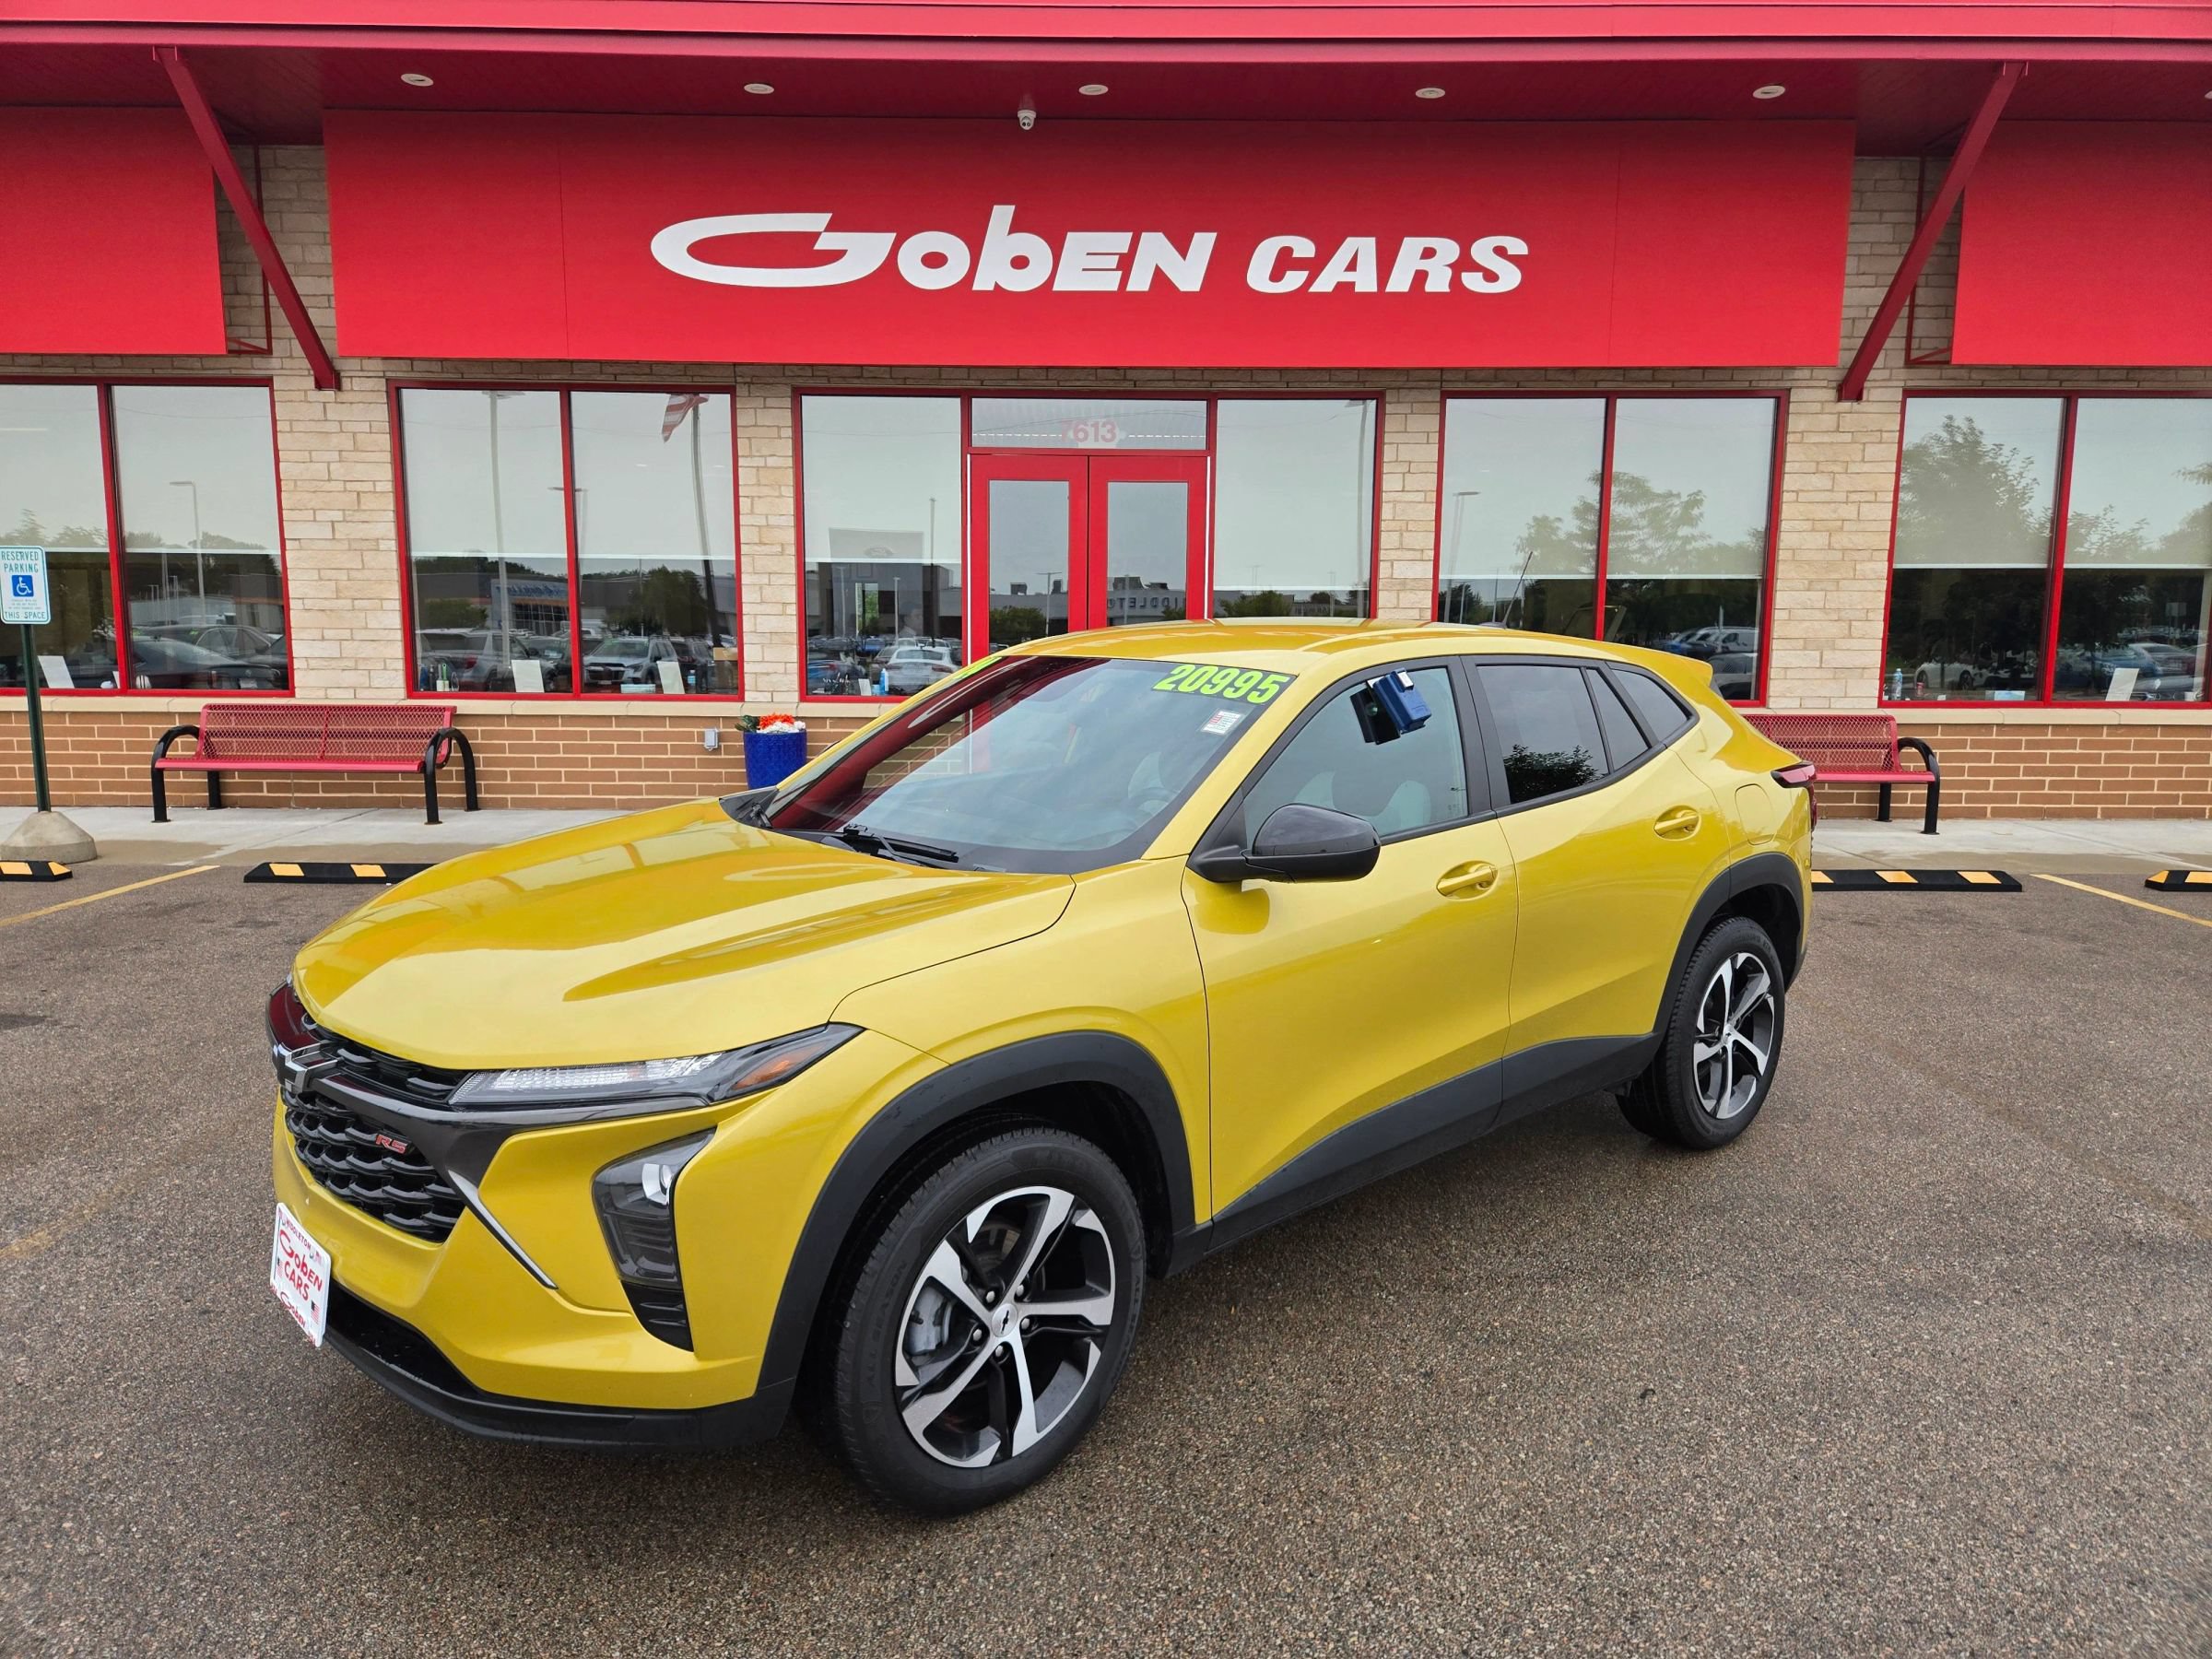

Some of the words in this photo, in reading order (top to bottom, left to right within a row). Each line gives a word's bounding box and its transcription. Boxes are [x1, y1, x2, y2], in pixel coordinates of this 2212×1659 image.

[1247, 234, 1529, 295] CARS
[1, 550, 40, 561] RESERVED
[4, 562, 40, 573] PARKING
[5, 611, 20, 619] THIS
[24, 611, 46, 619] SPACE
[1152, 664, 1291, 705] 20995
[375, 1134, 407, 1154] RS
[284, 1260, 310, 1301] CARS
